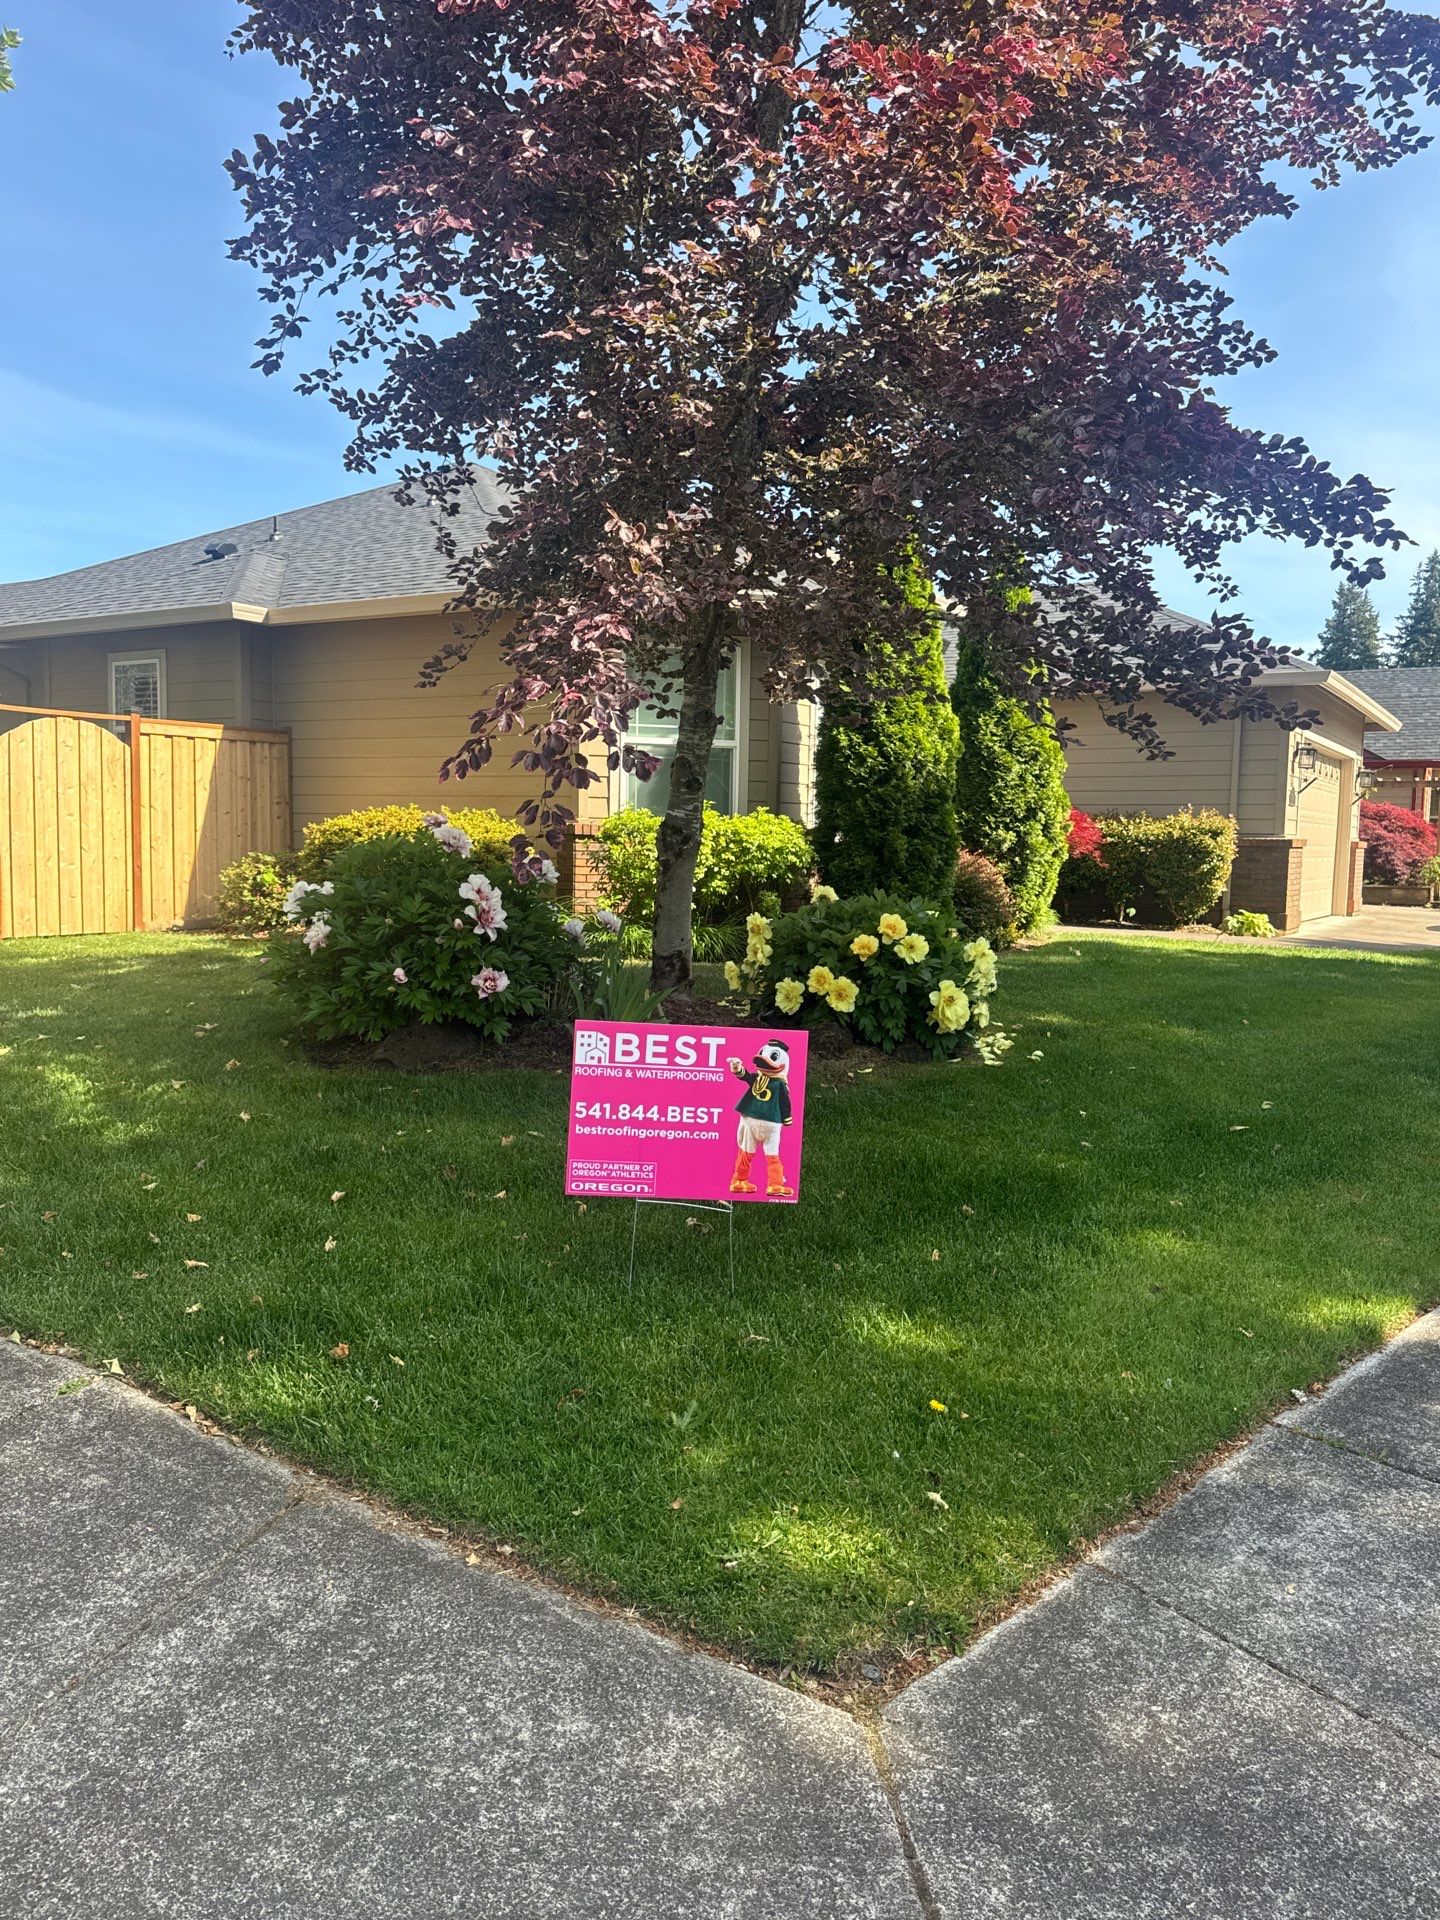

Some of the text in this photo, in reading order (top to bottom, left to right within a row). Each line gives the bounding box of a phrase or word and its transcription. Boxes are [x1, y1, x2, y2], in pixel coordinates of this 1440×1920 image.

[614, 1032, 726, 1067] BEST
[574, 1066, 724, 1082] ROOFING & WATERPROOFING
[575, 1101, 723, 1124] 541.844.BEST
[575, 1124, 720, 1140] bestroofingoregon.com
[572, 1161, 654, 1172] PROUD PARTNER OF
[610, 1170, 654, 1179] ATHLETICS
